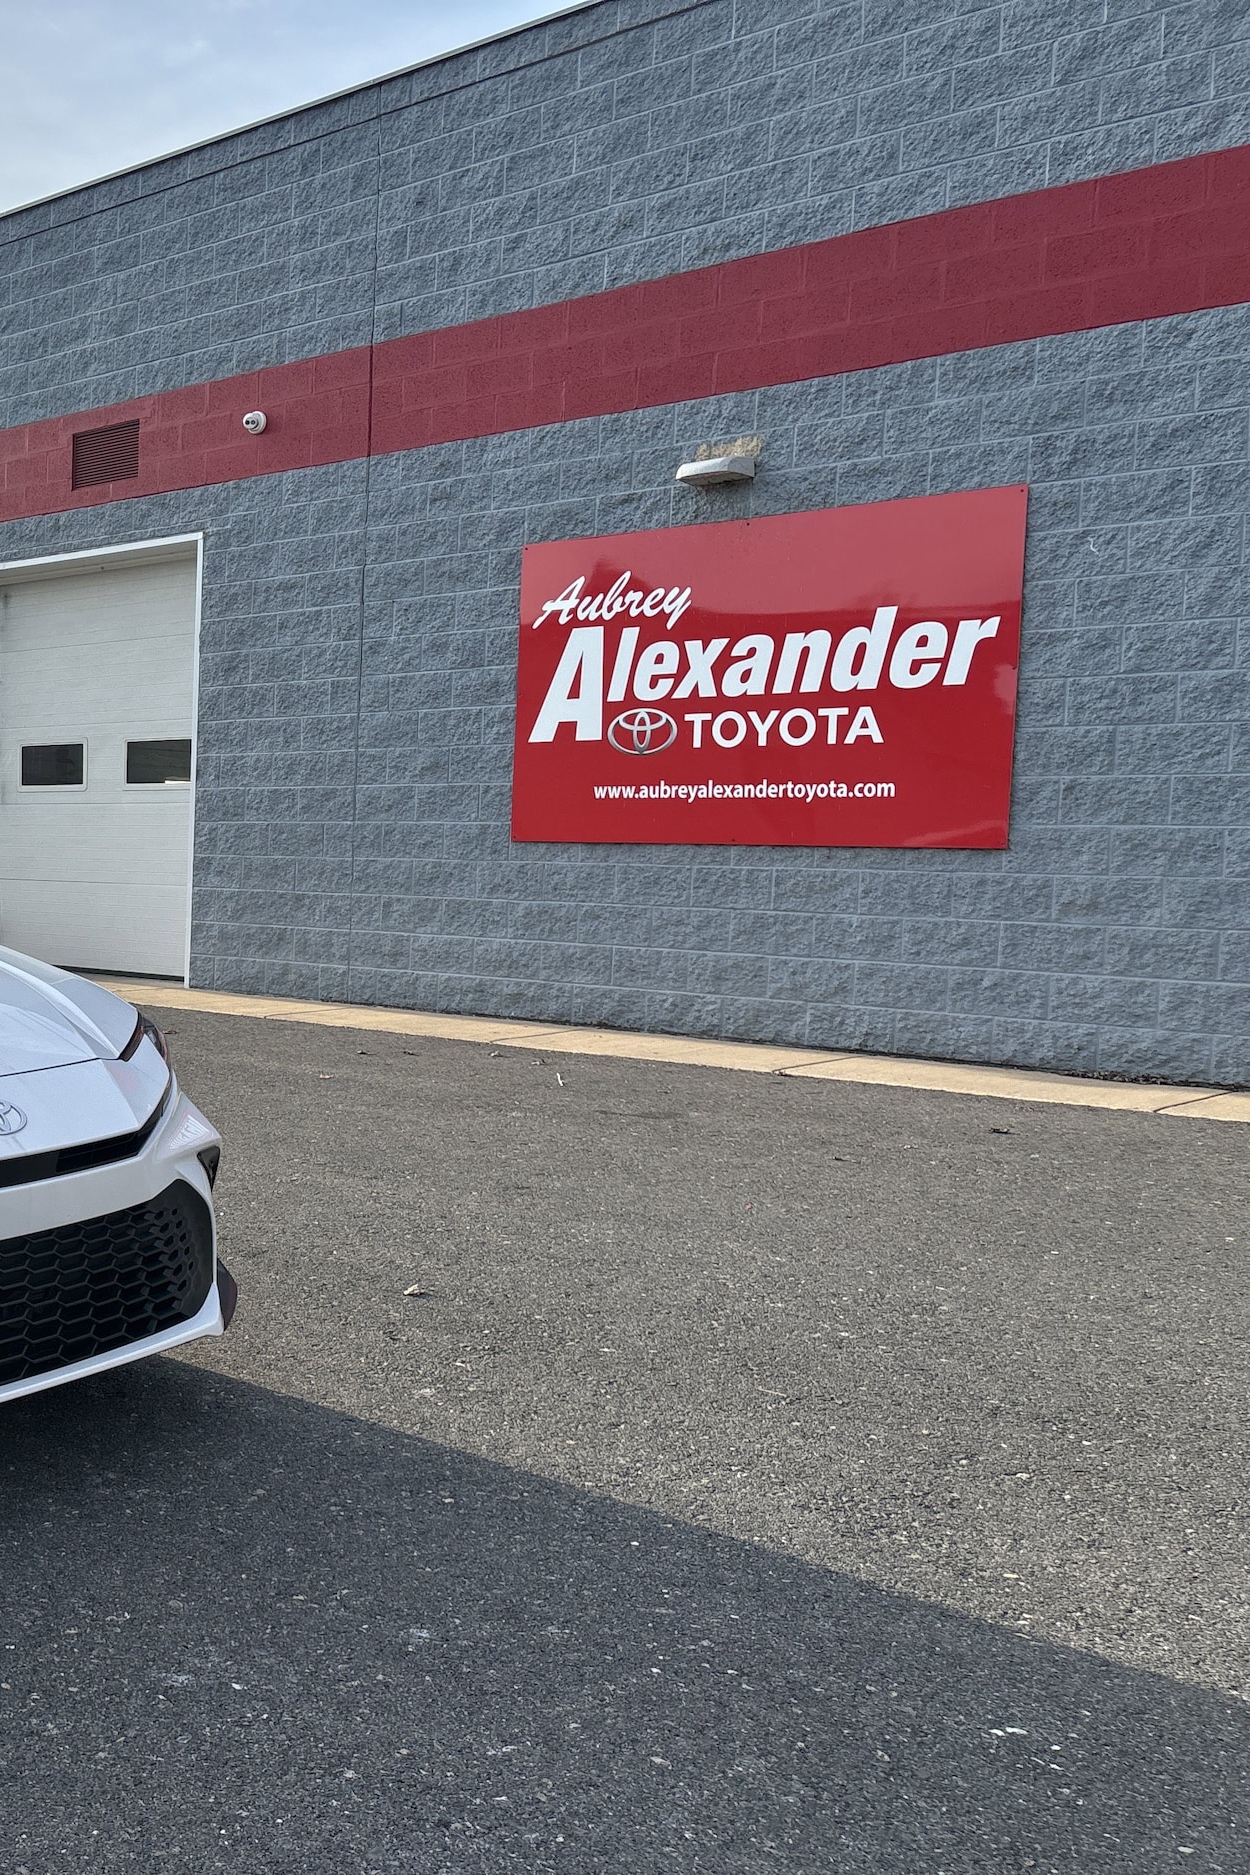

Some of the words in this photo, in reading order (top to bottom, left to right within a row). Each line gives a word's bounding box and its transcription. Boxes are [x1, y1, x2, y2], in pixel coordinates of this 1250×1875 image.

[532, 570, 692, 630] Aubrey
[528, 605, 1001, 743] Alexander
[684, 706, 884, 749] TOYOTA
[594, 778, 896, 803] www.aubreyalexandertoyota.com
